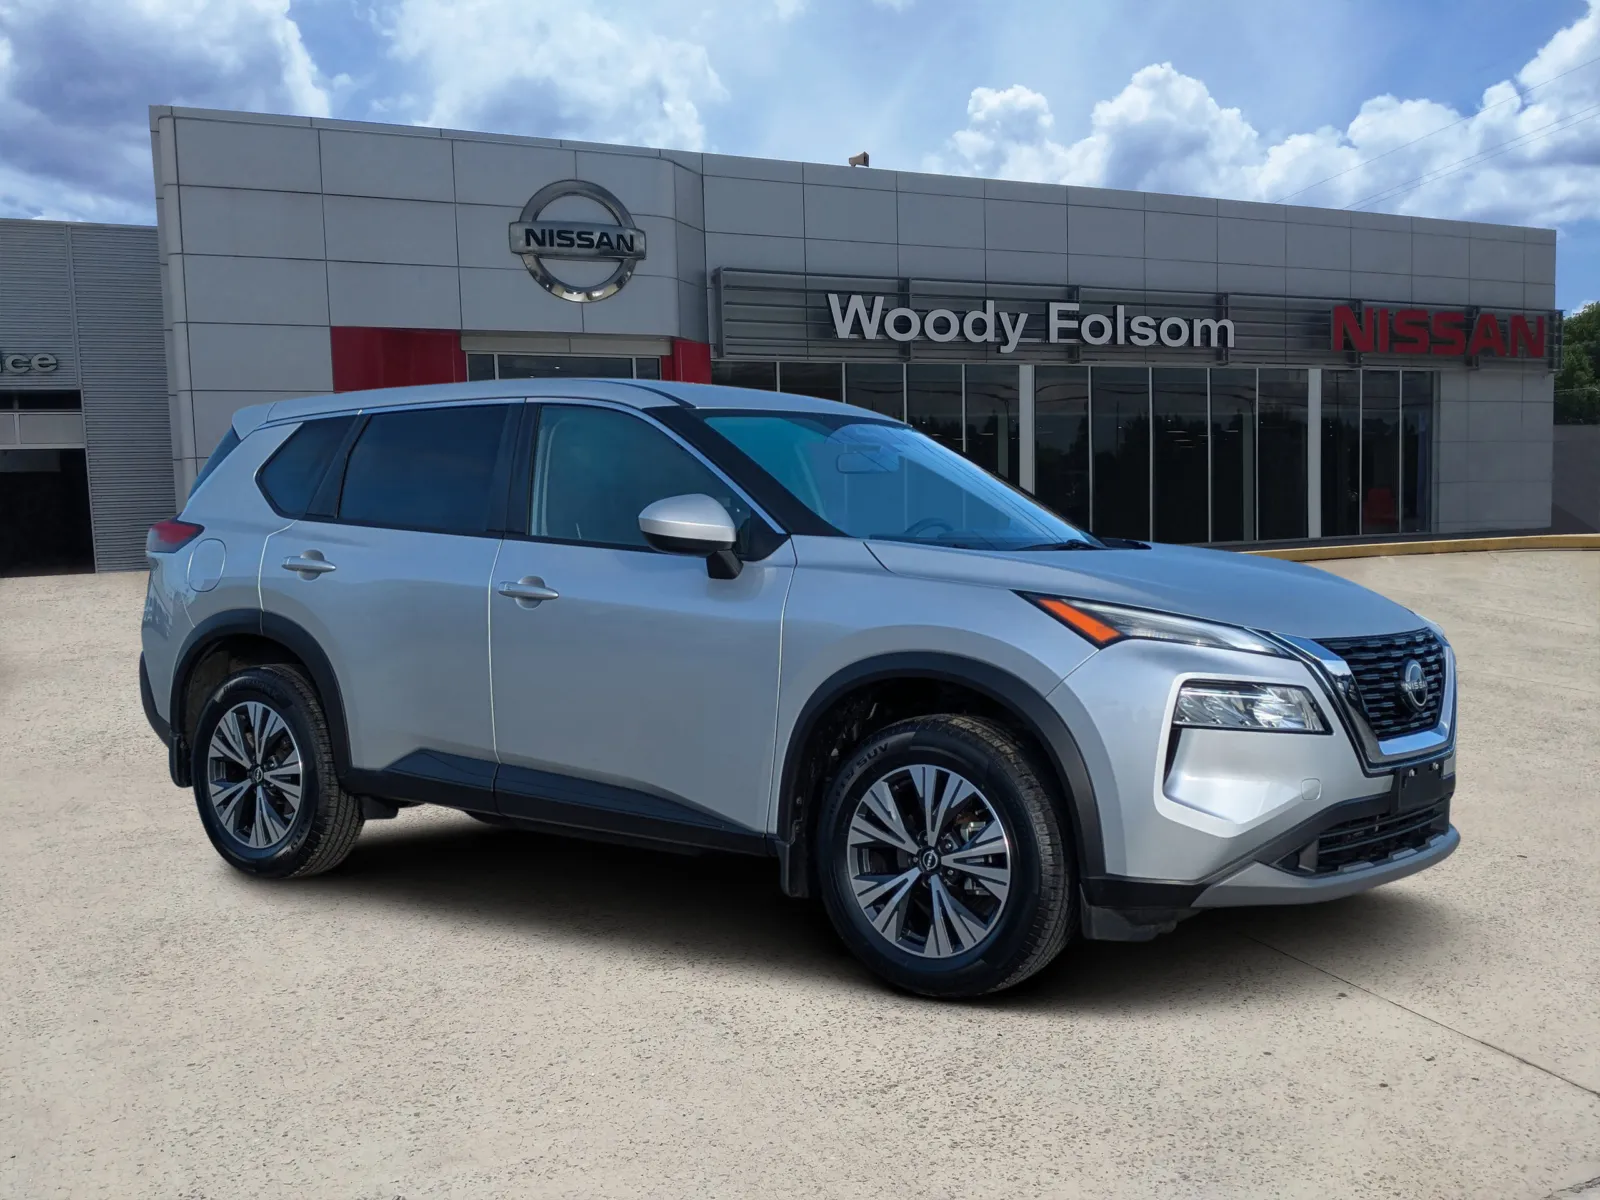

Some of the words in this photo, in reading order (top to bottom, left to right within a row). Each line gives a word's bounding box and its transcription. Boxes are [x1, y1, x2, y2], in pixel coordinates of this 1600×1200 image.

[525, 228, 634, 252] NISSAN
[826, 293, 1028, 354] Woody
[1047, 301, 1235, 348] Folsom
[1333, 305, 1545, 359] NISSAN
[0, 353, 57, 374] ce
